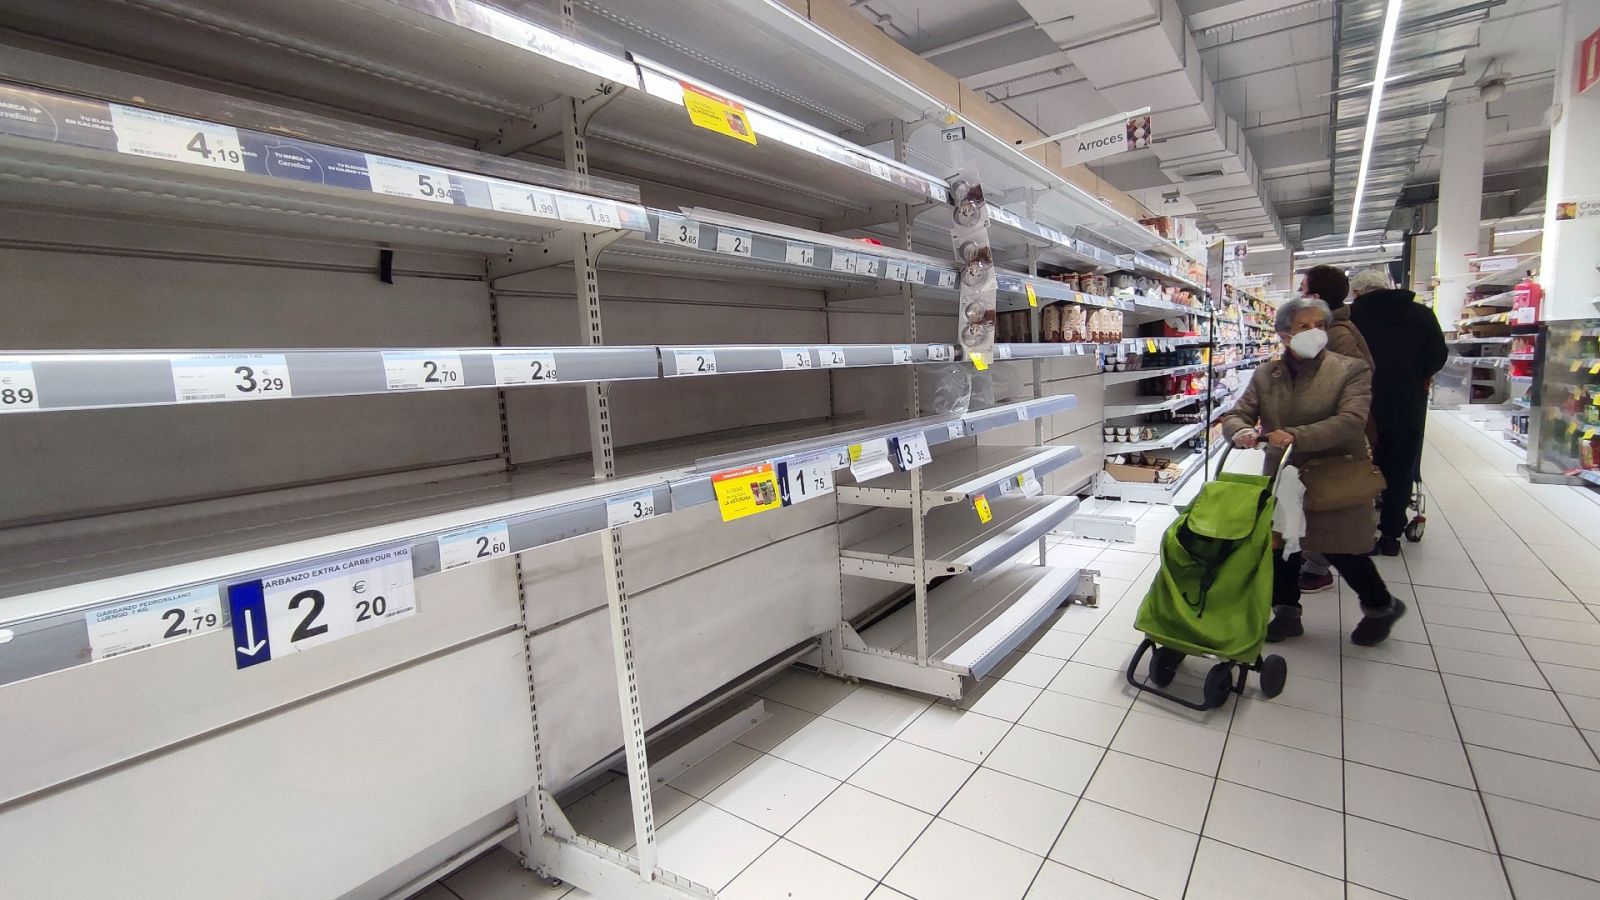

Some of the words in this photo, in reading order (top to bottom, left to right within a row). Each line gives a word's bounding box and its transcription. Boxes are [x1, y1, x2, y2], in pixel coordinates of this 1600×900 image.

[187, 131, 239, 163] 4,19
[1077, 132, 1124, 153] Arroces
[278, 160, 311, 171] Carrefour
[418, 174, 453, 200] 5,94
[526, 192, 553, 215] 1,99
[586, 203, 610, 224] 1,83
[679, 225, 697, 245] 3,65
[733, 237, 749, 254] 2,39
[423, 360, 457, 383] 2,70
[530, 360, 557, 380] 2,49
[696, 355, 715, 372] 2,95
[234, 366, 284, 393] 3,29
[2, 388, 33, 404] 89
[903, 443, 913, 465] 3
[796, 469, 805, 495] 1
[633, 501, 653, 518] 3,29
[476, 536, 506, 558] 2,60
[312, 564, 341, 577] EXTRA
[342, 552, 392, 571] CARREFOUR
[393, 548, 408, 558] 1KG
[96, 604, 138, 617] GARBANZO
[139, 592, 191, 607] PEDROSILLANO
[355, 595, 386, 623] 20
[97, 612, 128, 623] LUENGO
[161, 608, 217, 639] 2,79
[288, 589, 328, 643] 2
